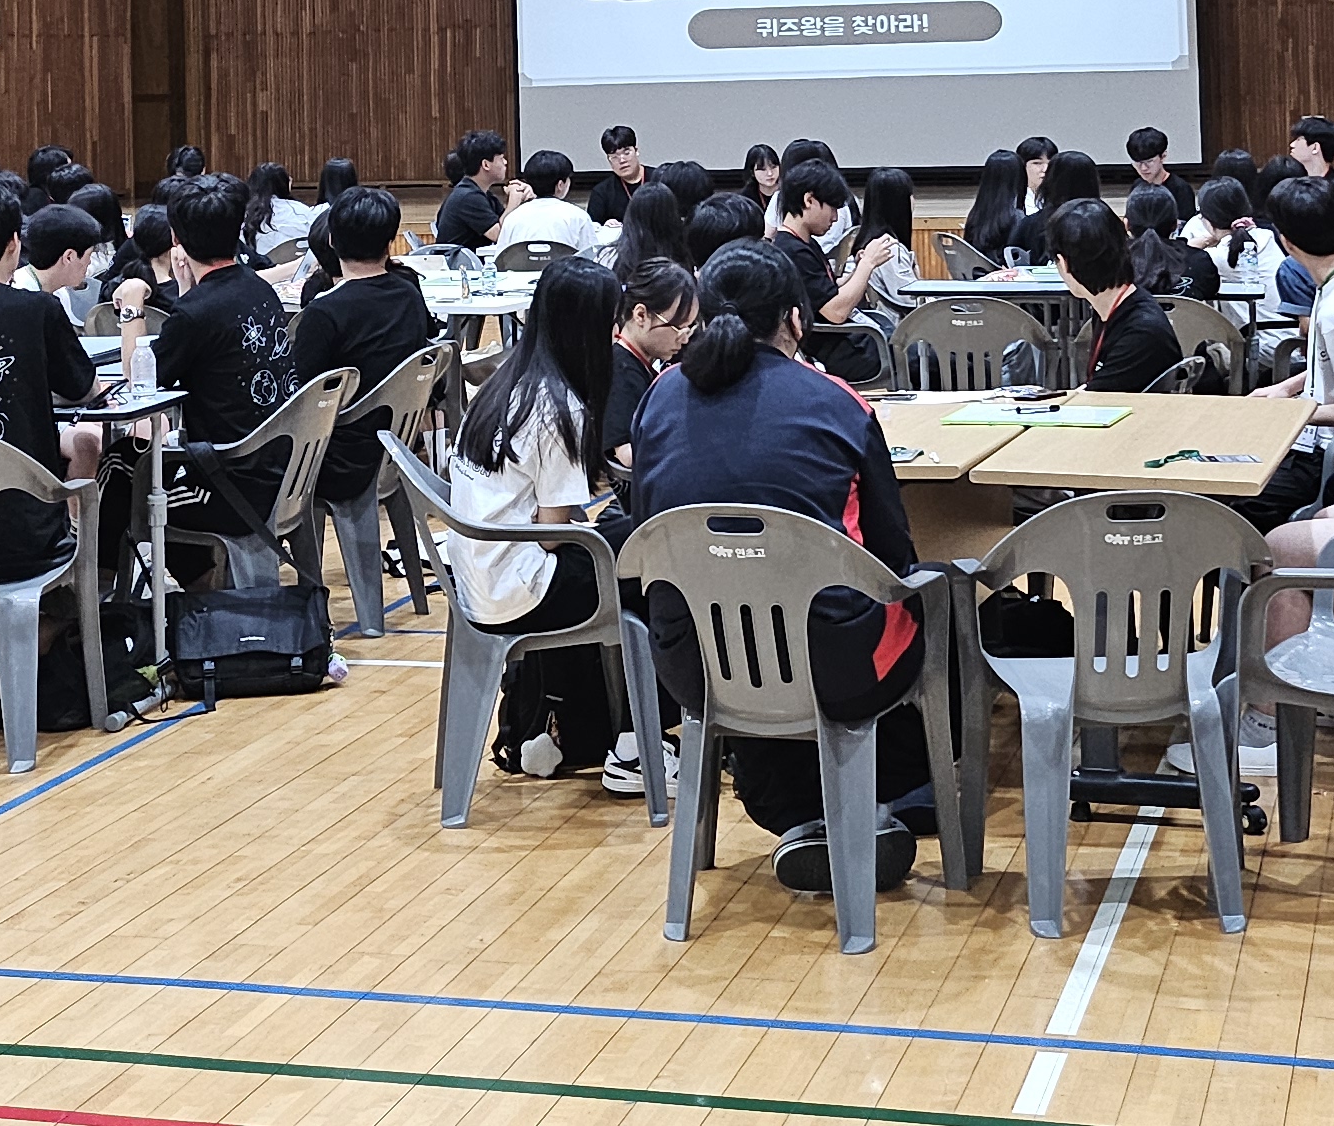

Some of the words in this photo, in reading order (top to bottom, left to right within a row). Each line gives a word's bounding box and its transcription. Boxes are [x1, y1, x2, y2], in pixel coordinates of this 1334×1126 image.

[756, 15, 845, 38] 퀴즈왕을
[851, 13, 929, 35] 찾아라!
[1134, 533, 1164, 545] 연초고
[734, 547, 766, 558] 연초고
